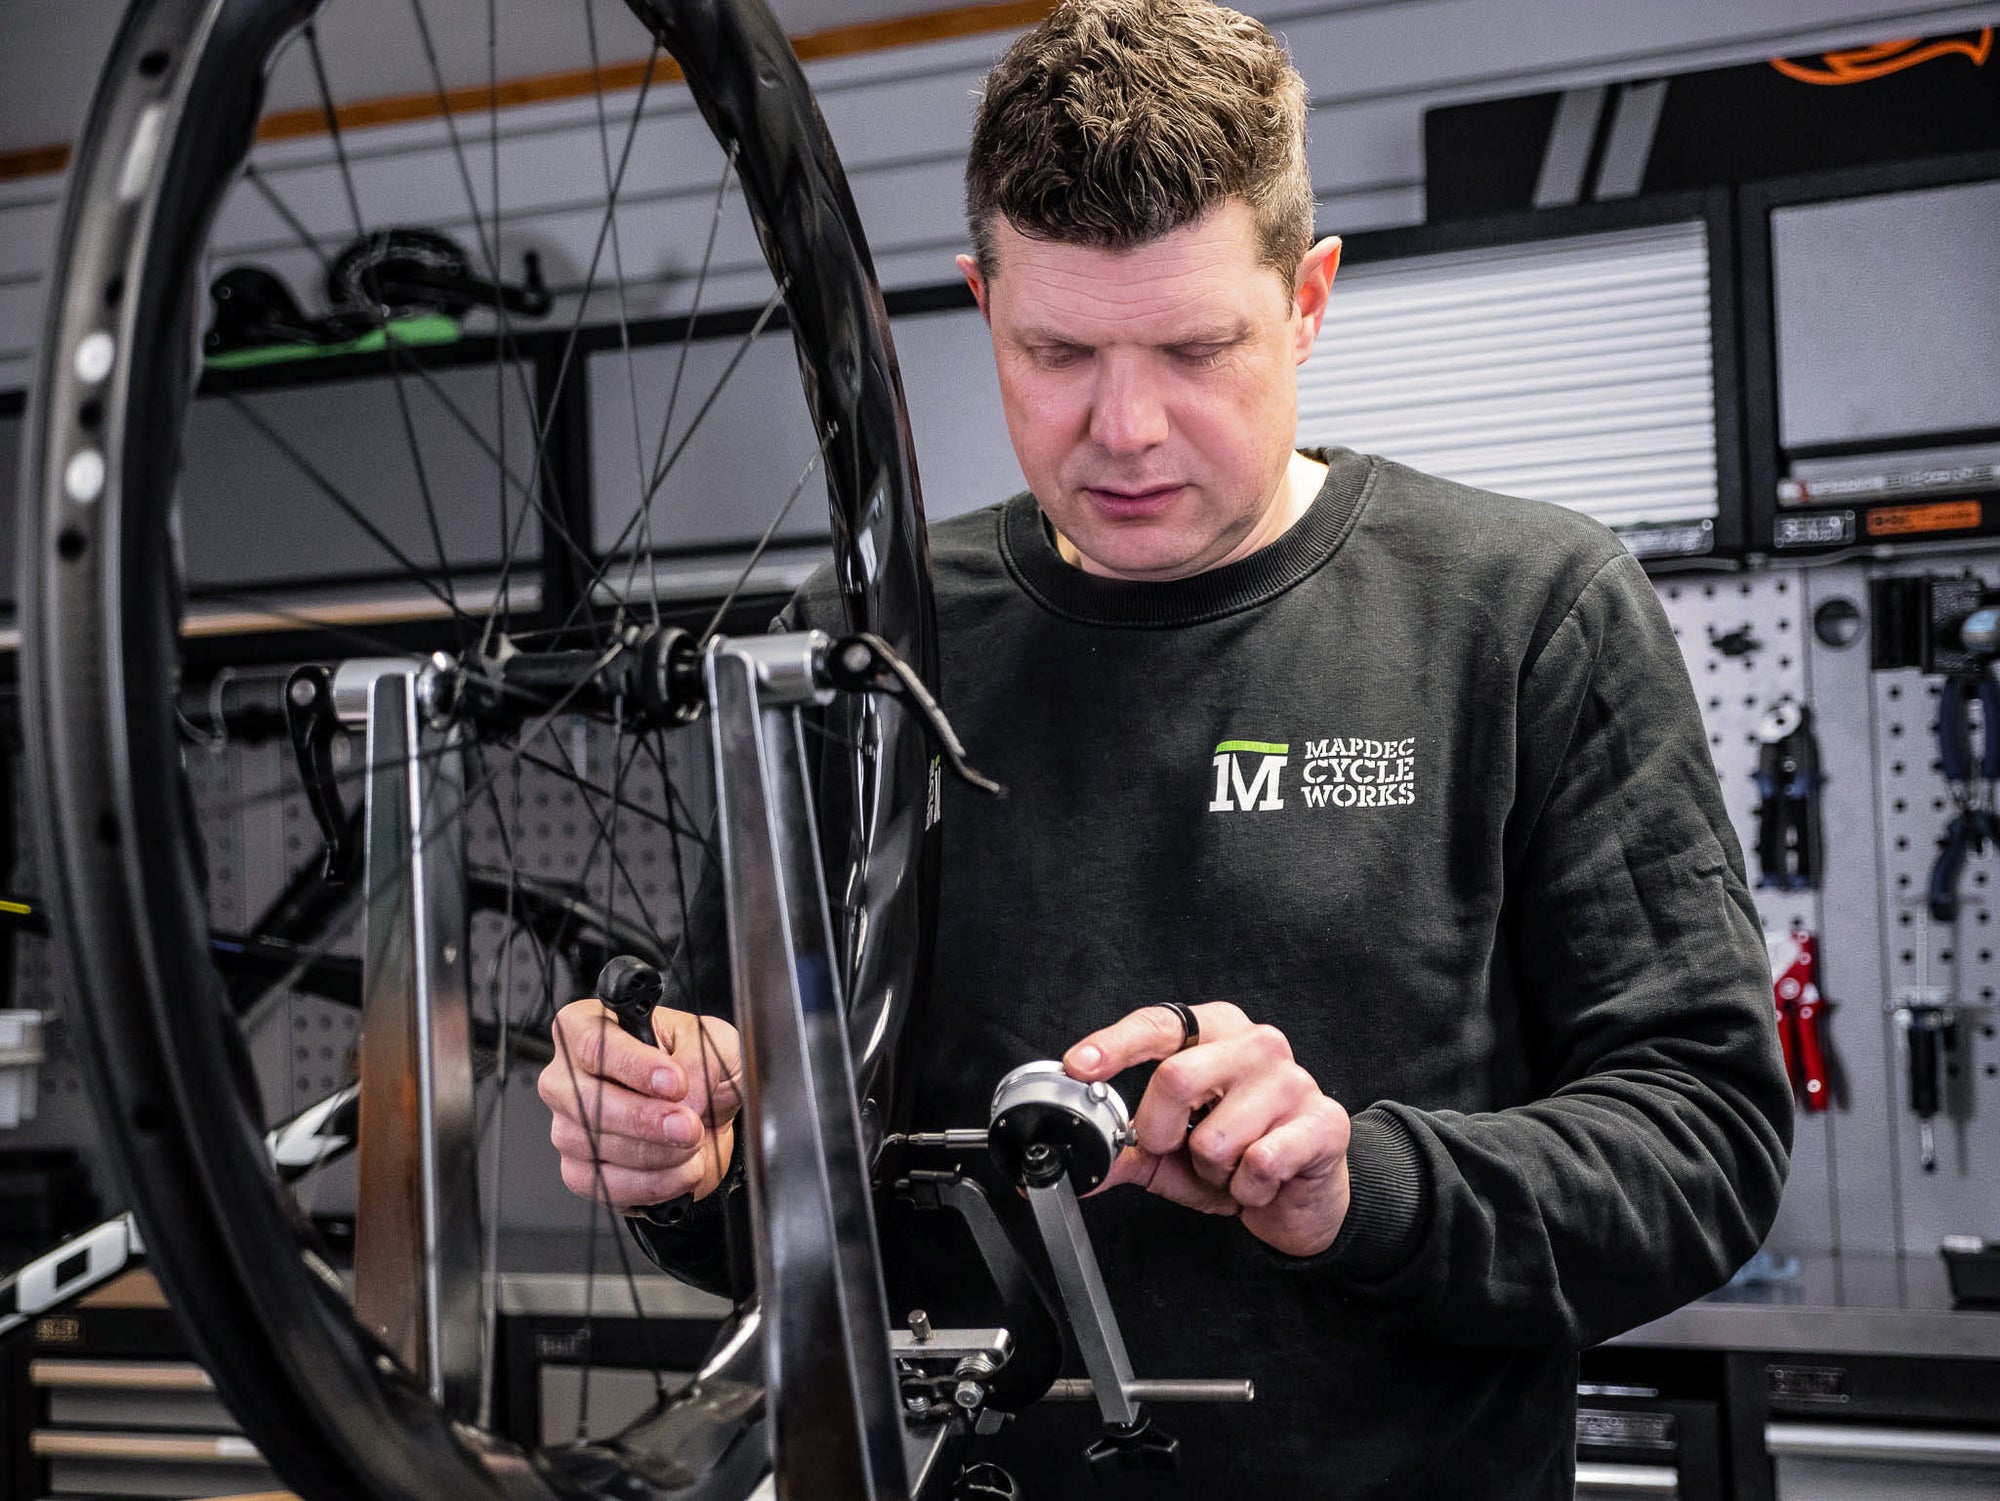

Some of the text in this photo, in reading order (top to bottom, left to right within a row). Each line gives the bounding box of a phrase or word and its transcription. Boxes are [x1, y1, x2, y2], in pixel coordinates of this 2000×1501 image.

[1305, 737, 1415, 760] MAPDEC
[1209, 753, 1288, 812] M
[1303, 757, 1414, 784] CYCLE
[1301, 783, 1415, 808] WORKS
